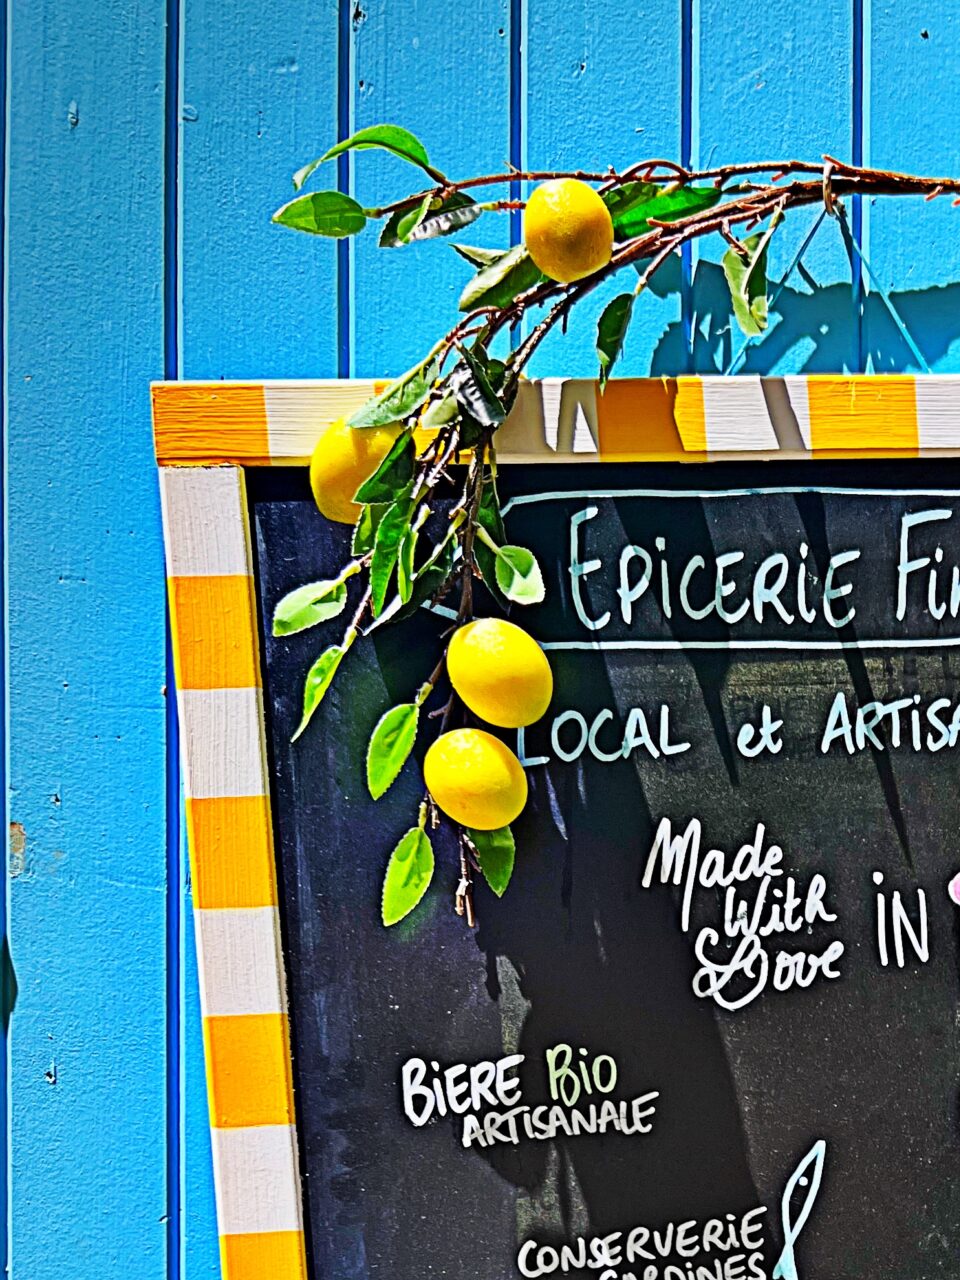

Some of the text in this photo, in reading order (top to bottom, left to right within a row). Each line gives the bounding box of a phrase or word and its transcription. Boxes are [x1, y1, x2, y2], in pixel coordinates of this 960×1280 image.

[517, 705, 691, 767] LOCAL
[737, 706, 784, 757] et
[641, 818, 784, 931] Made
[725, 878, 836, 936] With
[693, 934, 845, 1010] Love
